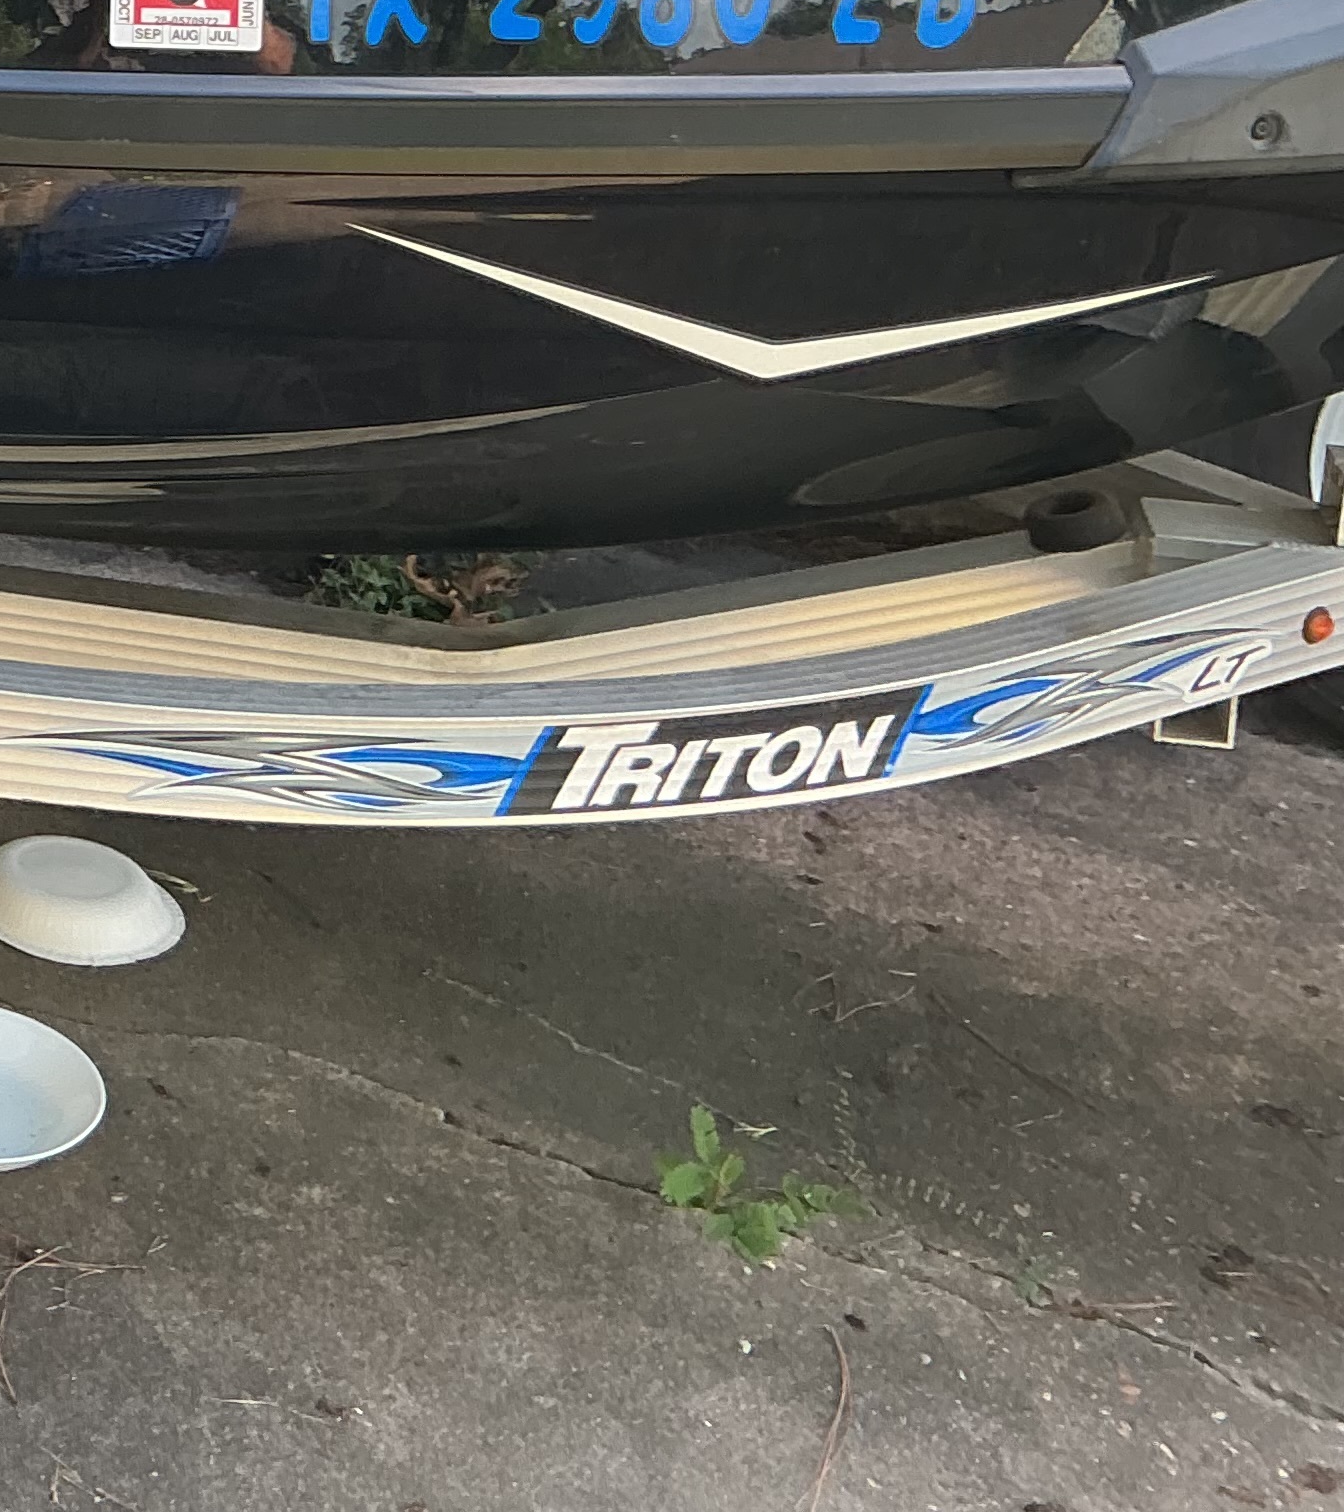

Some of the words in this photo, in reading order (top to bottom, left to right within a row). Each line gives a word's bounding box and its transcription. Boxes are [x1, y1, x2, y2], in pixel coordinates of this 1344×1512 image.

[242, 1, 254, 26] JUN
[134, 28, 161, 40] SEP
[172, 29, 198, 41] AUG
[209, 31, 236, 43] JUL
[1189, 645, 1266, 693] LT
[552, 711, 896, 813] TRITON
